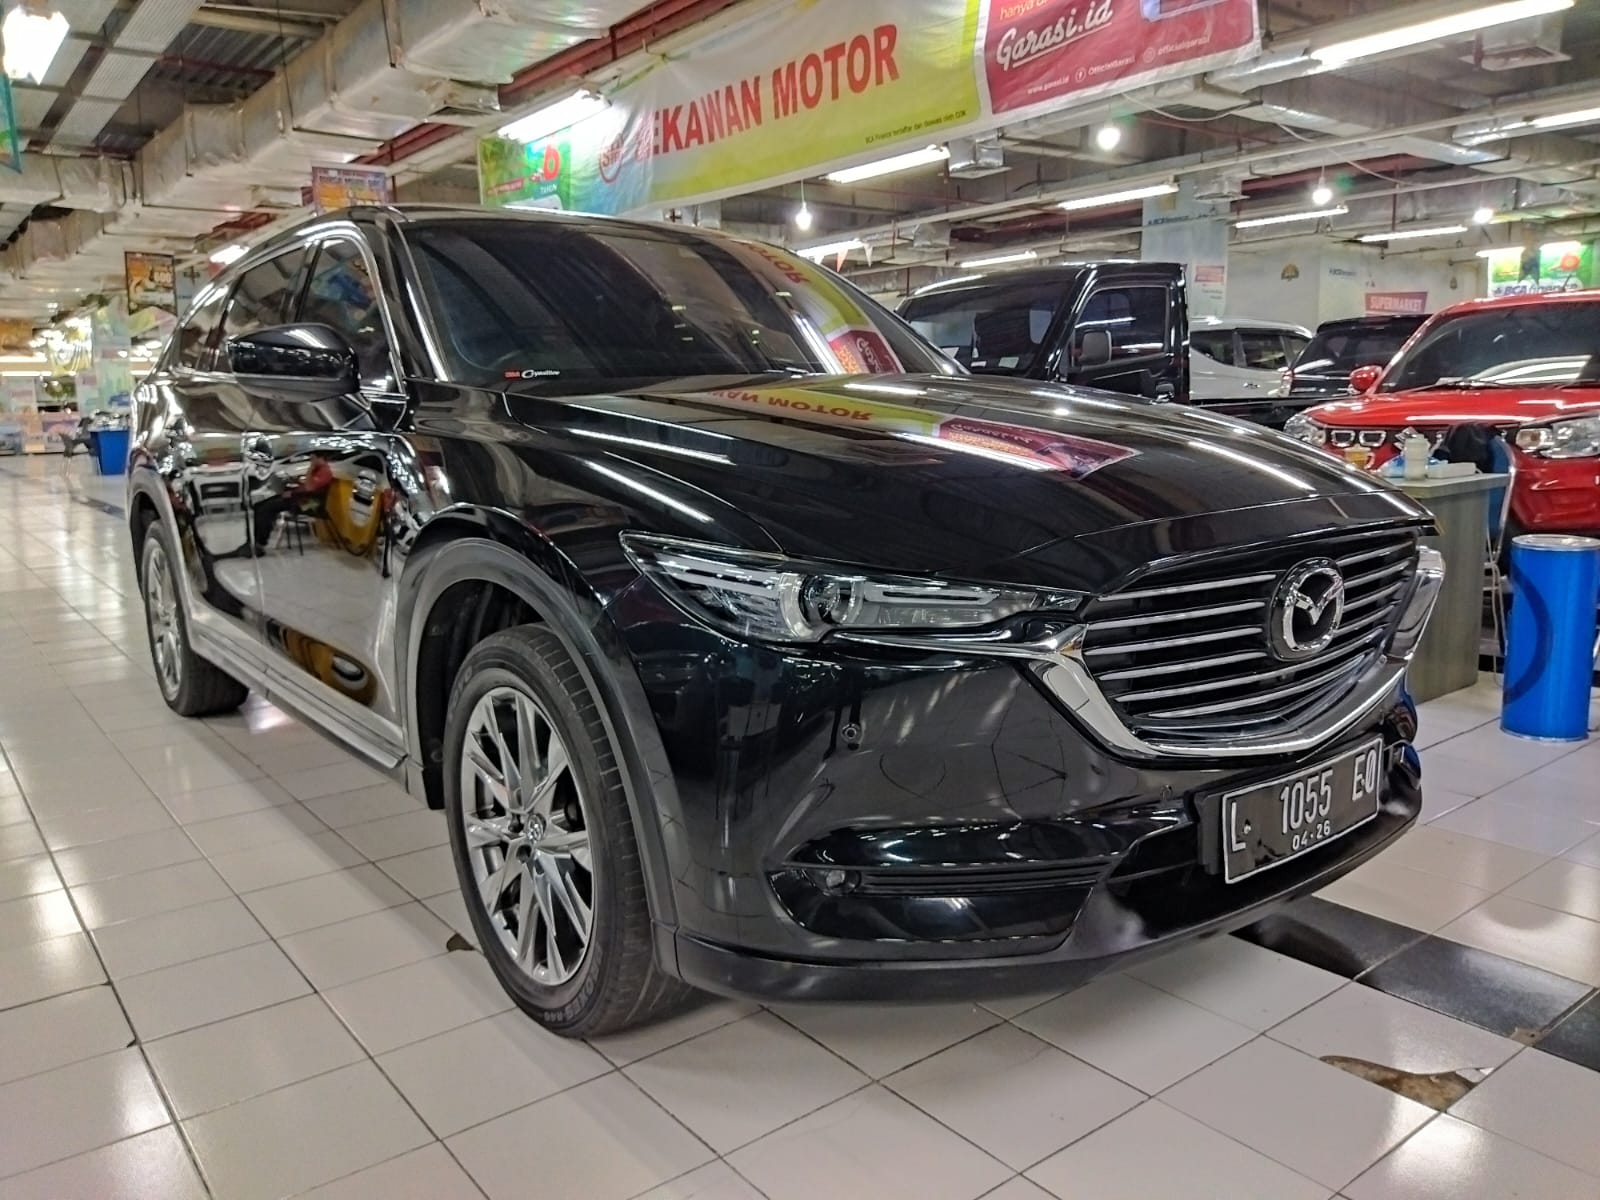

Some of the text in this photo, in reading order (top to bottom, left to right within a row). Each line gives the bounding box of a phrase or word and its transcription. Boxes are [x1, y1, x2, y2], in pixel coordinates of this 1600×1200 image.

[772, 24, 899, 119] MOTOR
[996, 0, 1113, 71] Garasi.id
[1231, 802, 1246, 852] L
[1280, 768, 1334, 834] 1055
